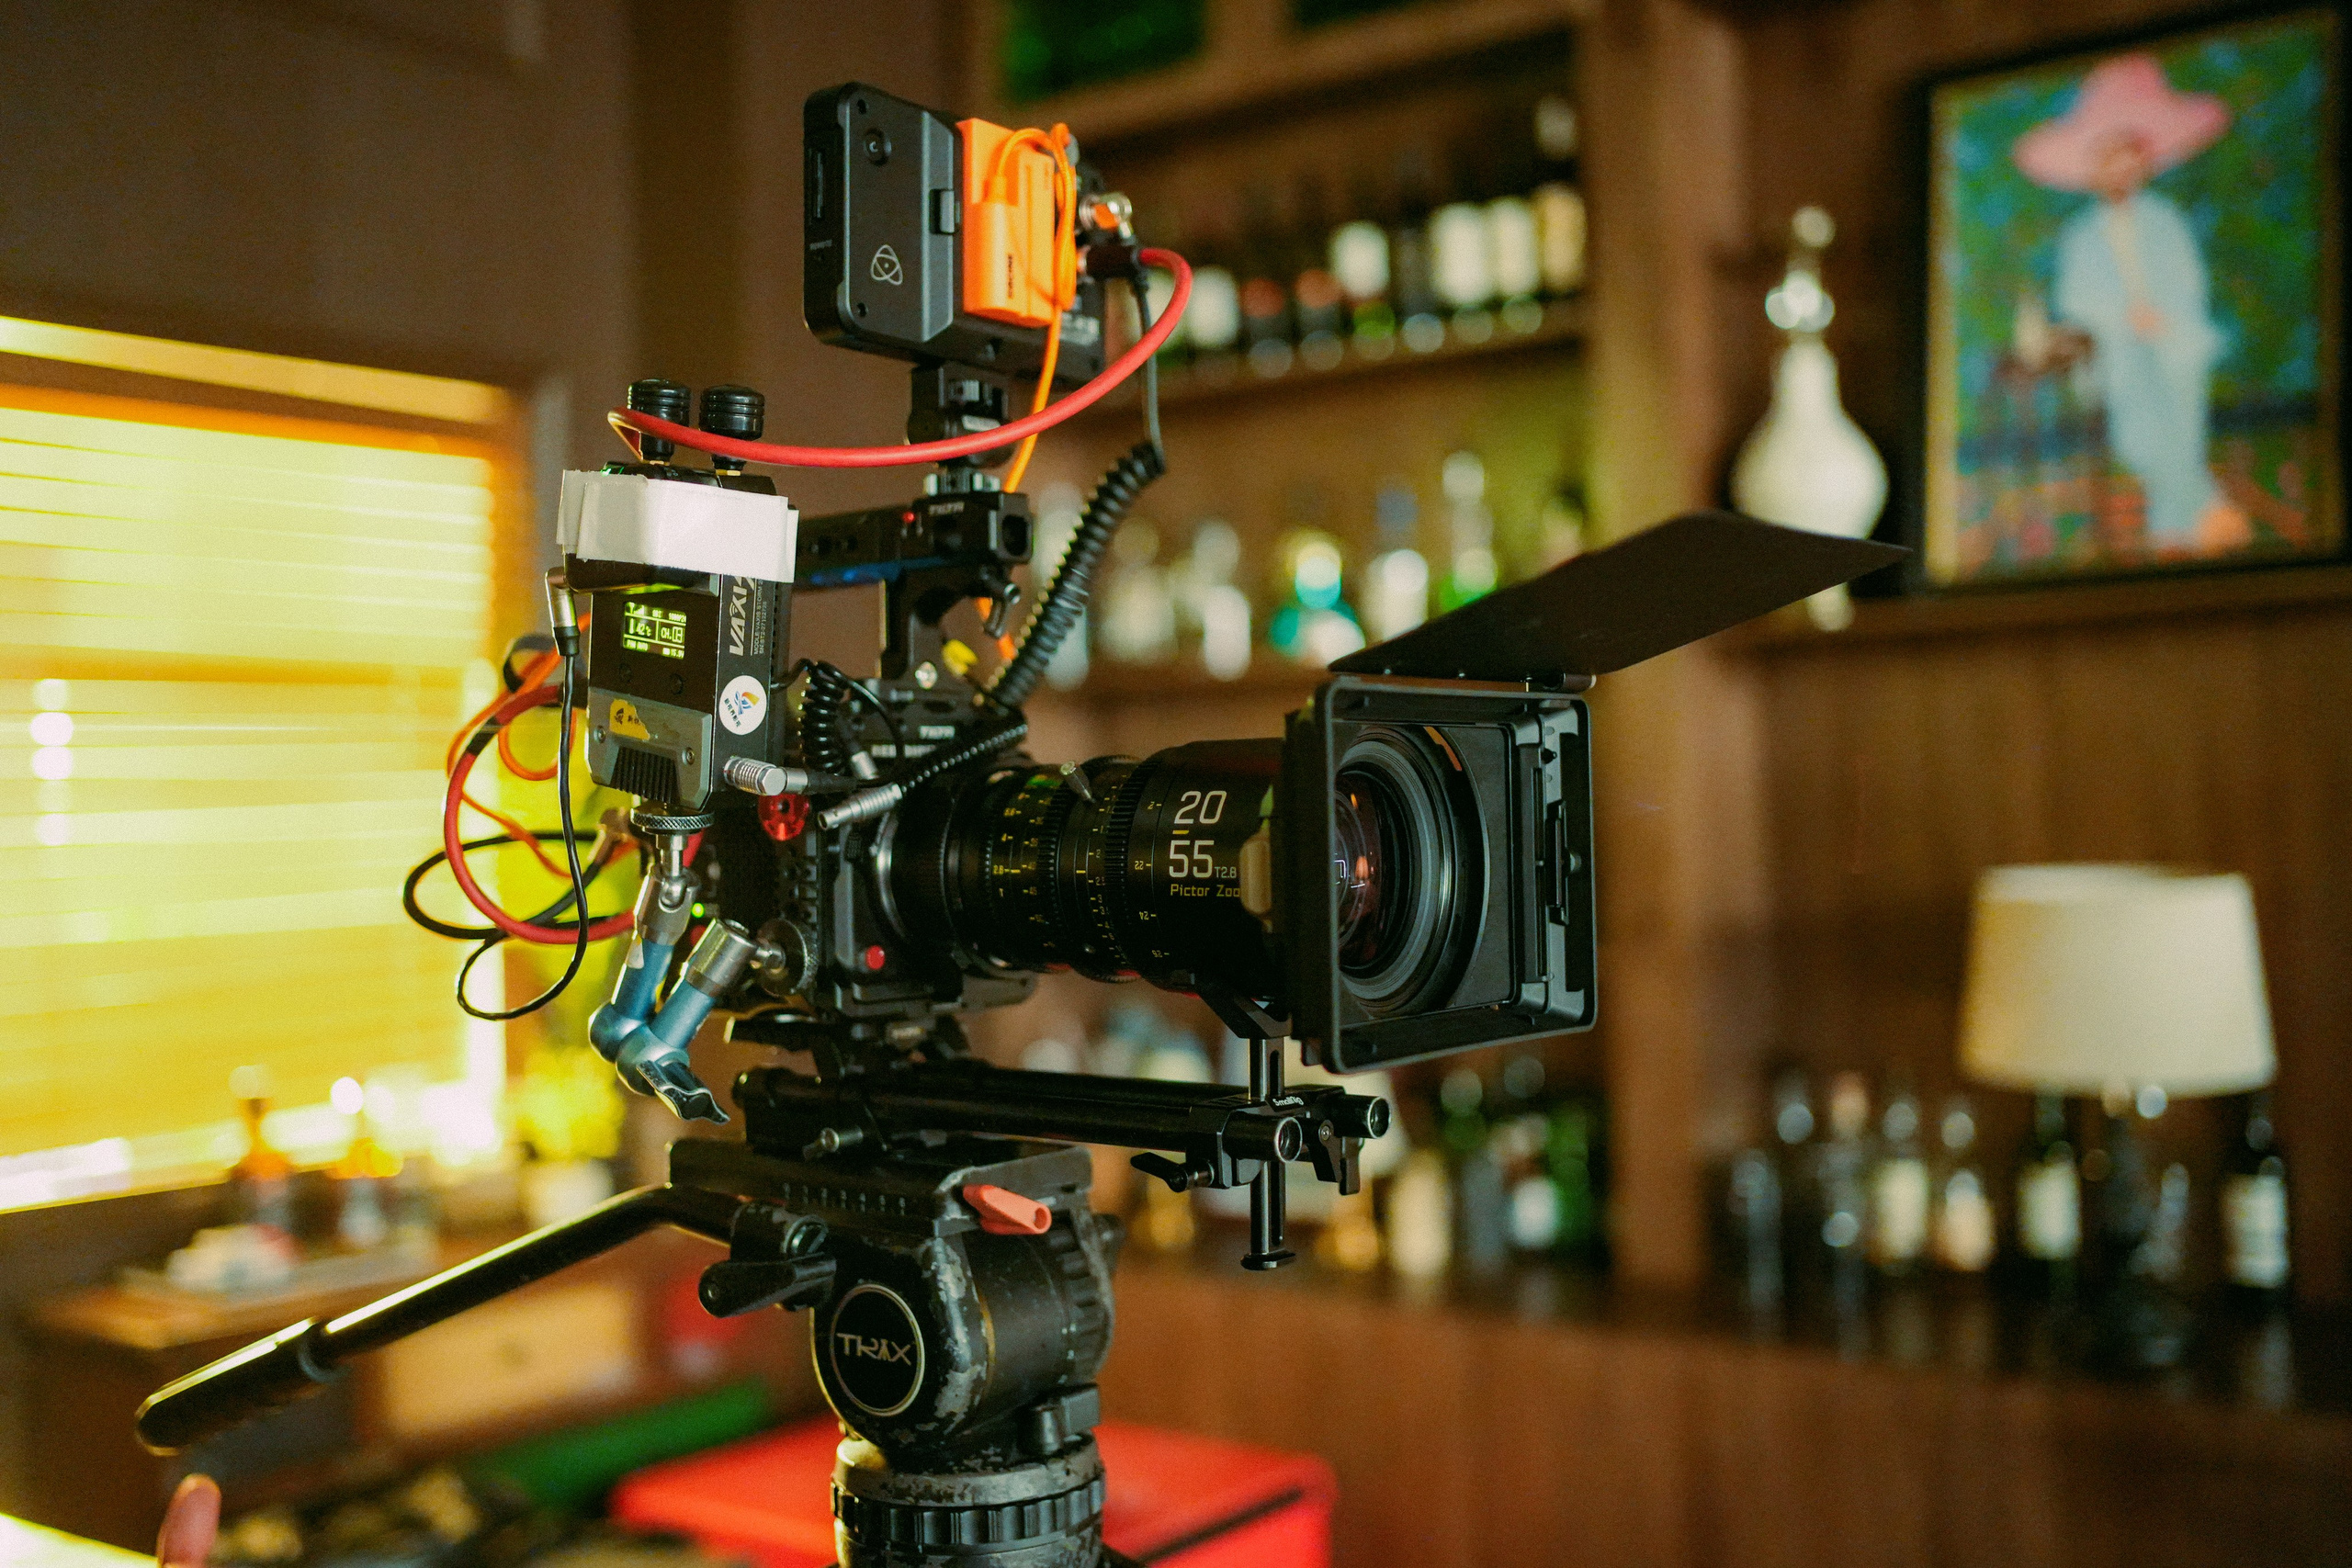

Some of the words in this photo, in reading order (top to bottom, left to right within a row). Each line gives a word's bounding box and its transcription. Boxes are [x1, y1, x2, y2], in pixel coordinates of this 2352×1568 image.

[1174, 790, 1227, 824] 20
[1169, 840, 1215, 878] 55
[1214, 866, 1238, 879] T2.8
[1170, 884, 1211, 897] Pictor
[1216, 885, 1241, 897] Zoo
